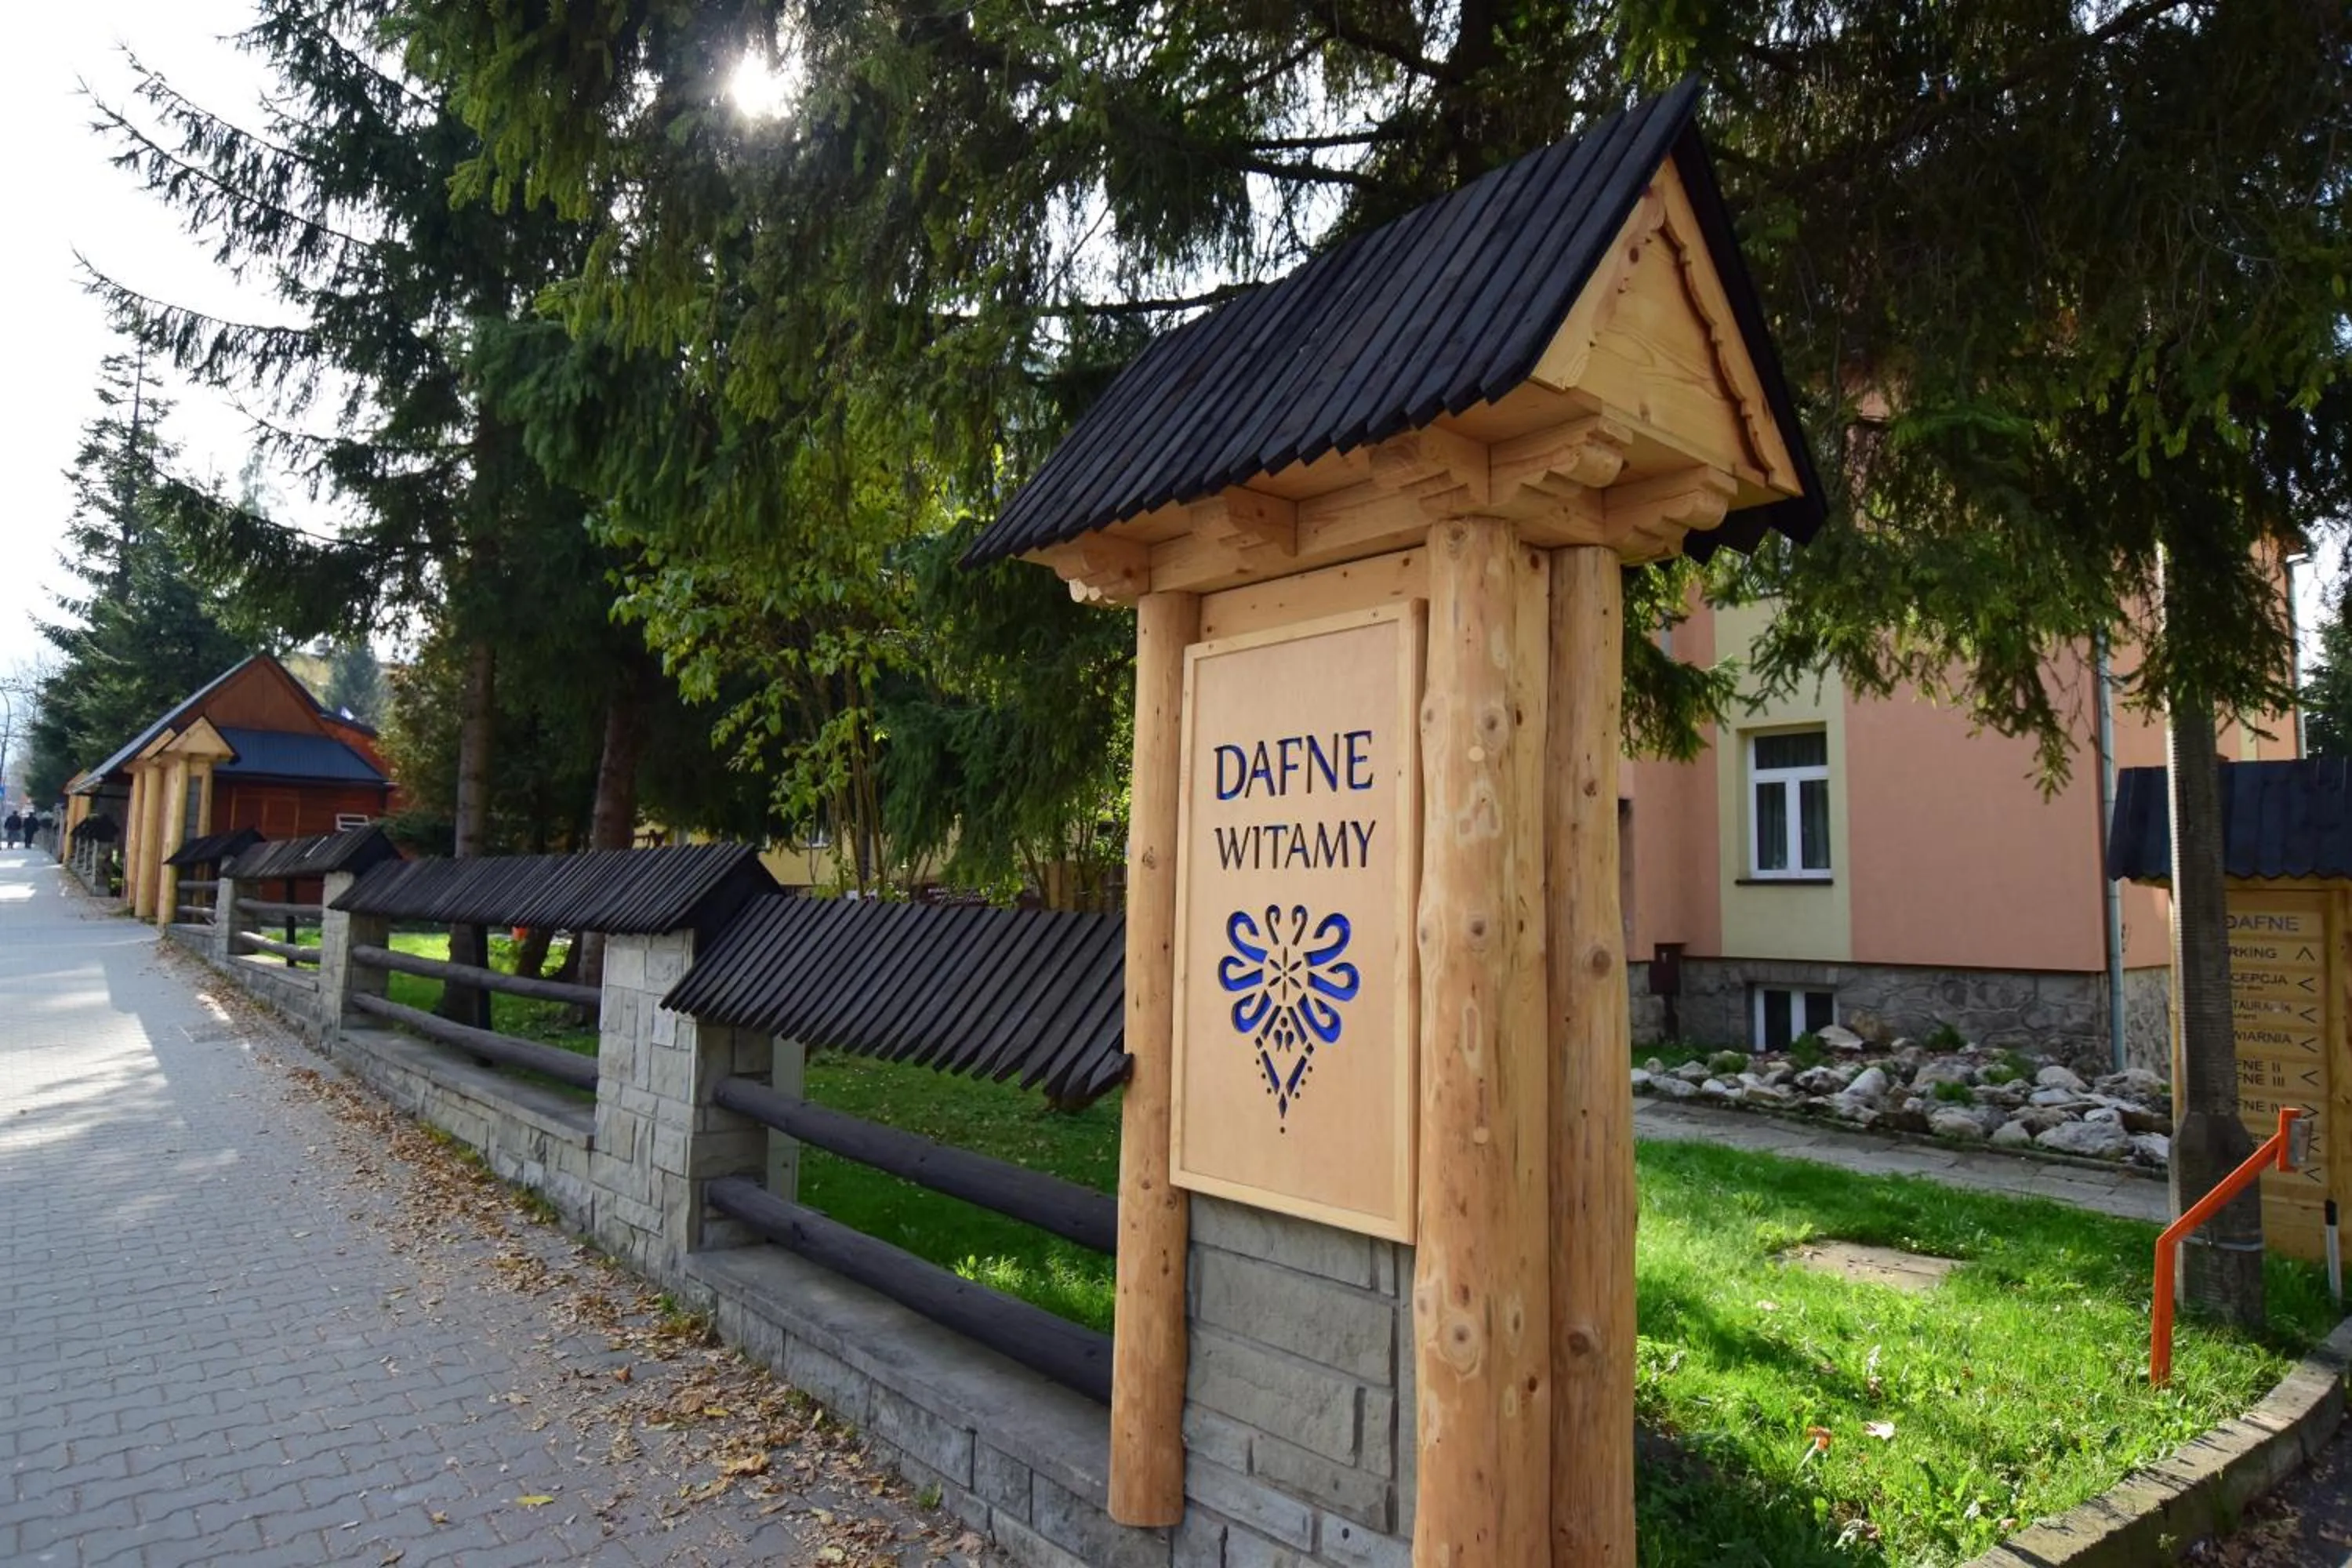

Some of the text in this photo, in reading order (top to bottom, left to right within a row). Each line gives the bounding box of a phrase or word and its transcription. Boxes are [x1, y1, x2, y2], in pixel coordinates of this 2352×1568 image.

[1214, 730, 1374, 800] DAFNE
[1214, 820, 1376, 870] WITAMY
[2227, 915, 2300, 931] DAFNE
[2228, 946, 2277, 959] RKING
[2230, 973, 2288, 985] CEPCJA
[2234, 1030, 2292, 1044] WIARNIA
[2235, 1058, 2264, 1072] FNE
[2235, 1072, 2265, 1086] FNE
[2236, 1098, 2265, 1112] FNE
